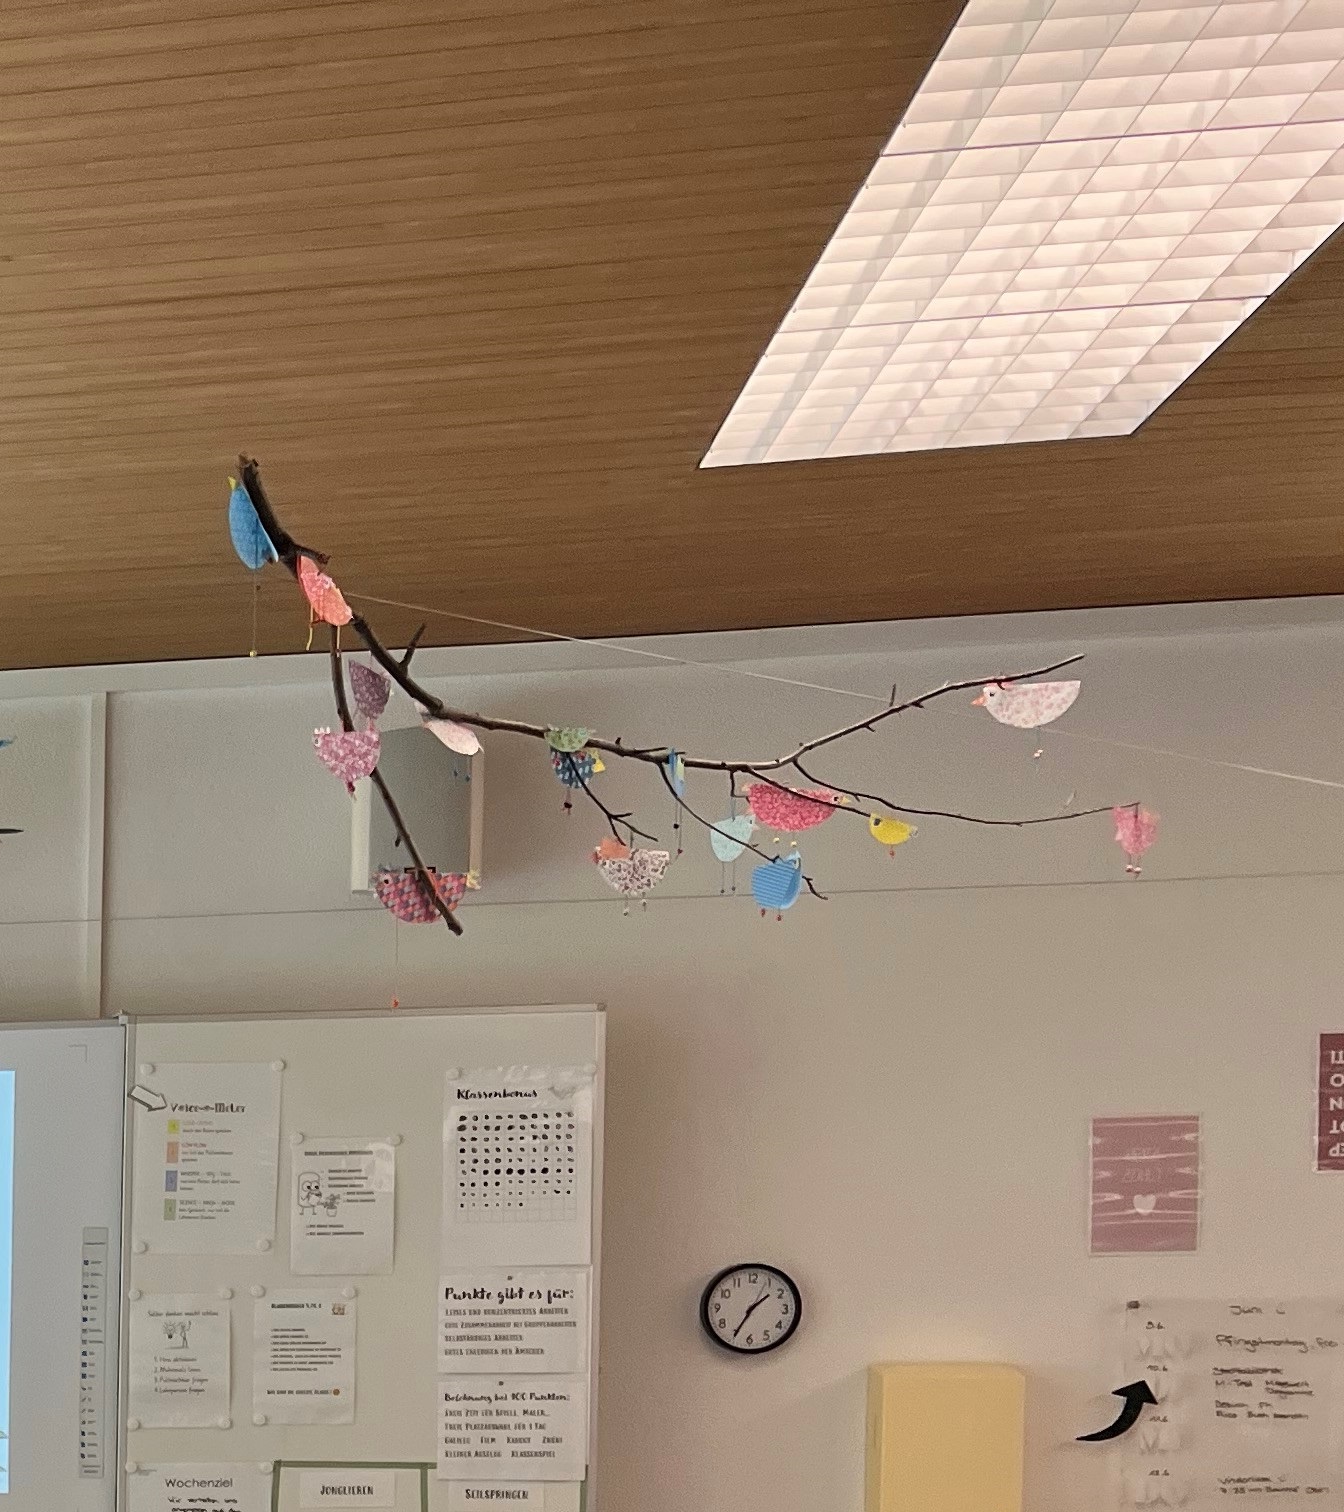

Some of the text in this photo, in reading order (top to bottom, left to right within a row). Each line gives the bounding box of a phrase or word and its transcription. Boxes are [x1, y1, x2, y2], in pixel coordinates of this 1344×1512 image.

[733, 1278, 741, 1288] 11
[748, 1272, 758, 1284] 12
[445, 1287, 575, 1304] Punkte gibt es für:
[721, 1288, 731, 1299] 10
[777, 1288, 784, 1299] 2
[714, 1303, 721, 1313] 9
[782, 1303, 789, 1315] 3
[718, 1318, 726, 1328] 8
[775, 1320, 782, 1329] 4
[746, 1334, 753, 1344] 6
[763, 1330, 770, 1340] 5
[165, 1478, 233, 1488] Wochenziel
[320, 1484, 374, 1496] JONGLIEREN
[465, 1488, 529, 1500] SEILSPRINGEN
